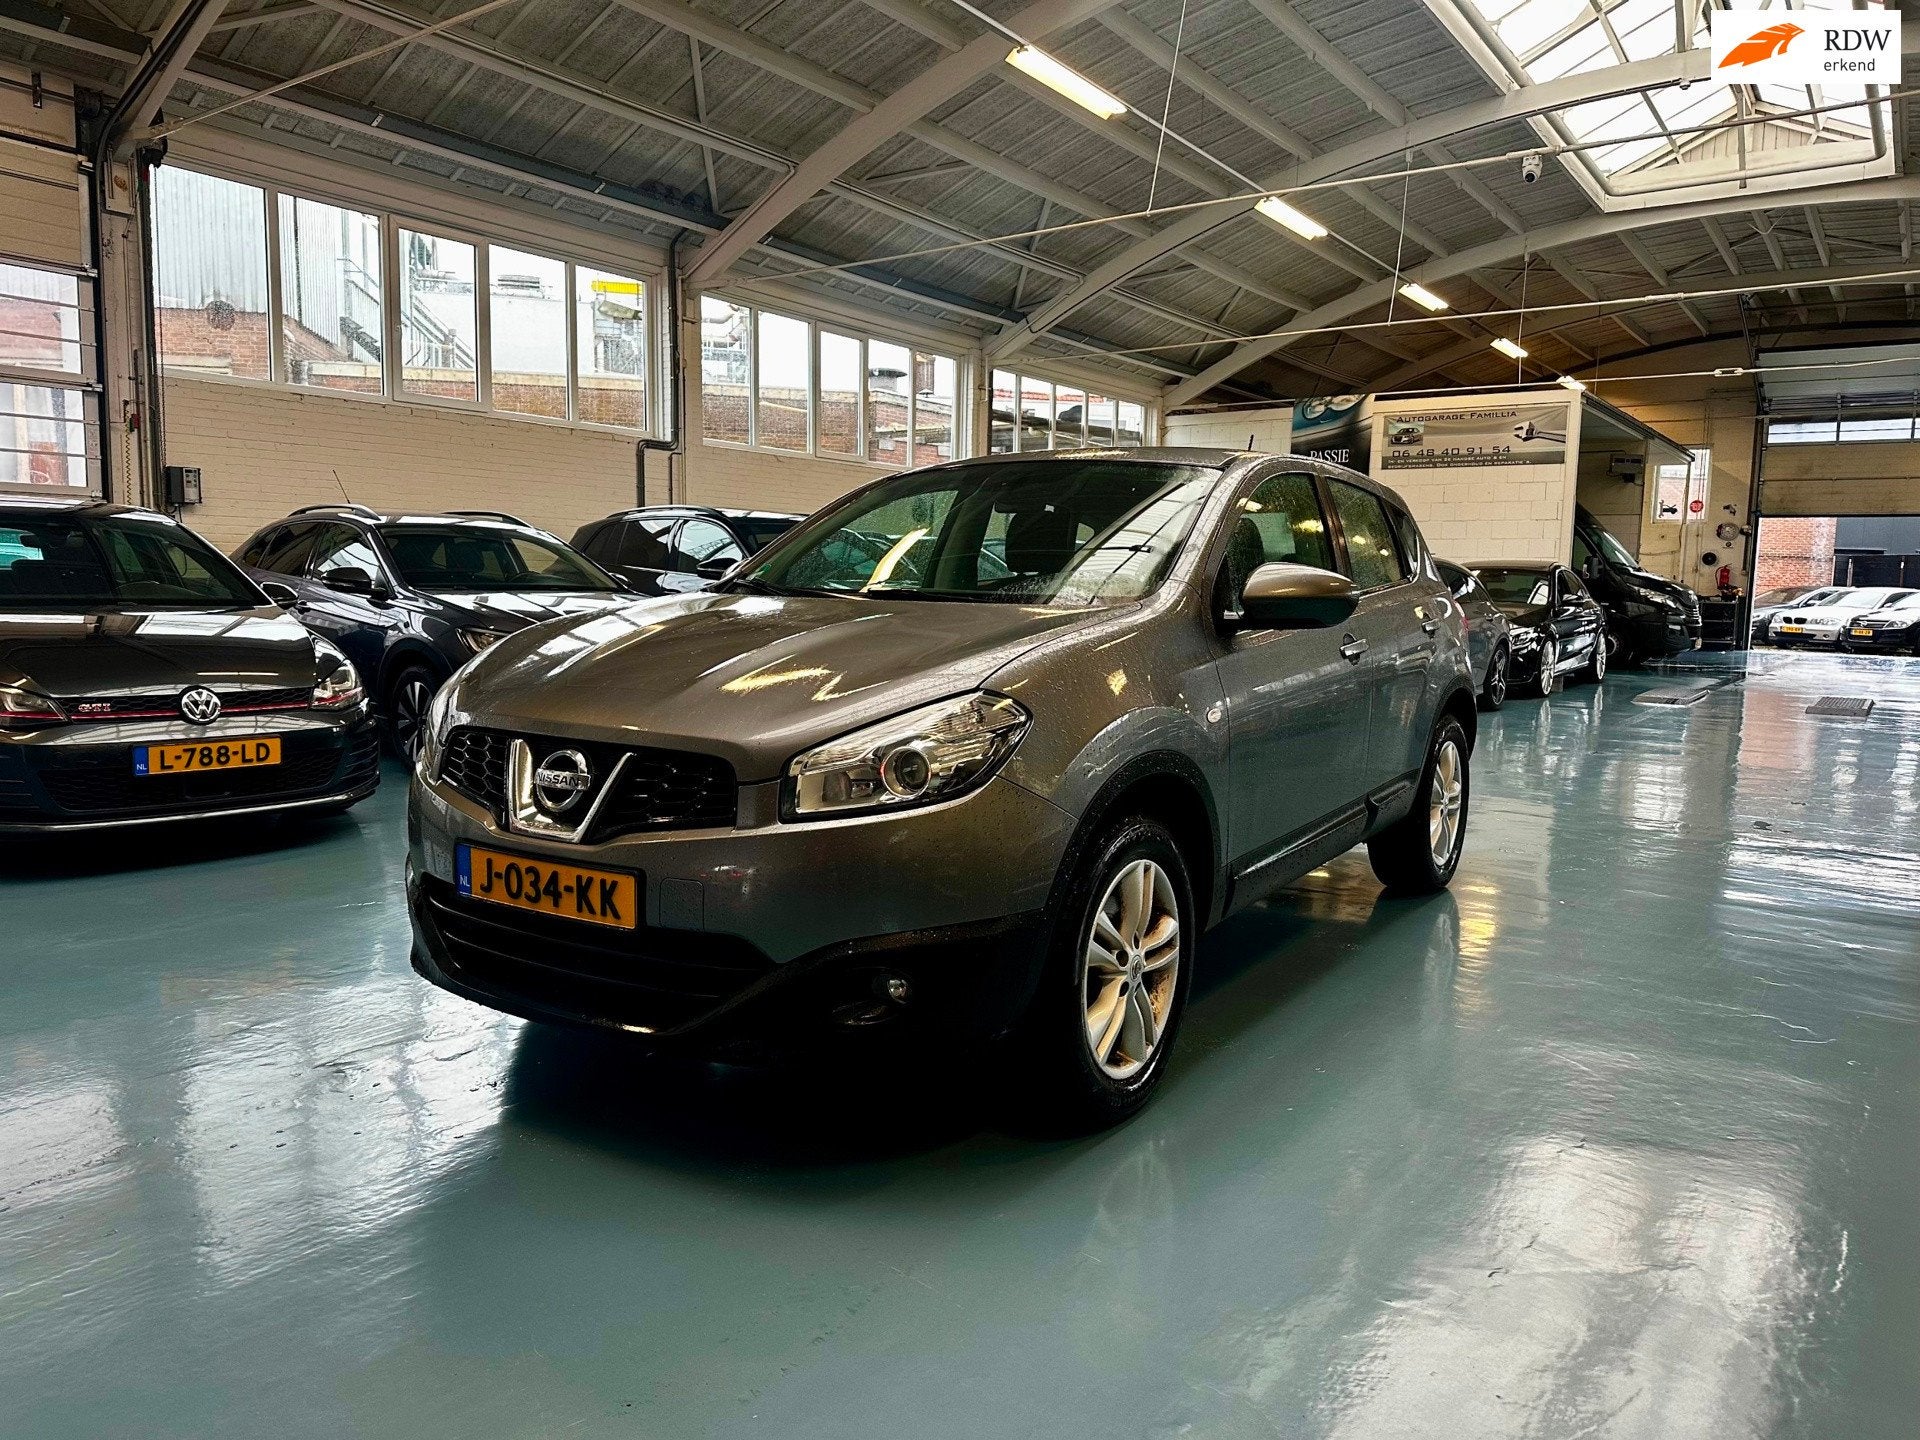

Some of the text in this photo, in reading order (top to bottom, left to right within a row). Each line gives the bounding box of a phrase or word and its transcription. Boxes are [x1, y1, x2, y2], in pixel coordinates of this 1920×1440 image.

[1310, 449, 1349, 463] PASSIE
[1416, 448, 1435, 457] 48
[1441, 447, 1460, 456] 40
[1466, 446, 1483, 455] 91
[1492, 445, 1511, 454] 54
[78, 703, 111, 712] GTI
[160, 742, 270, 770] L-788-LD
[136, 763, 147, 771] NL
[538, 772, 579, 787] NISSAN
[459, 876, 470, 887] NL
[480, 857, 621, 920] J-034-KK
